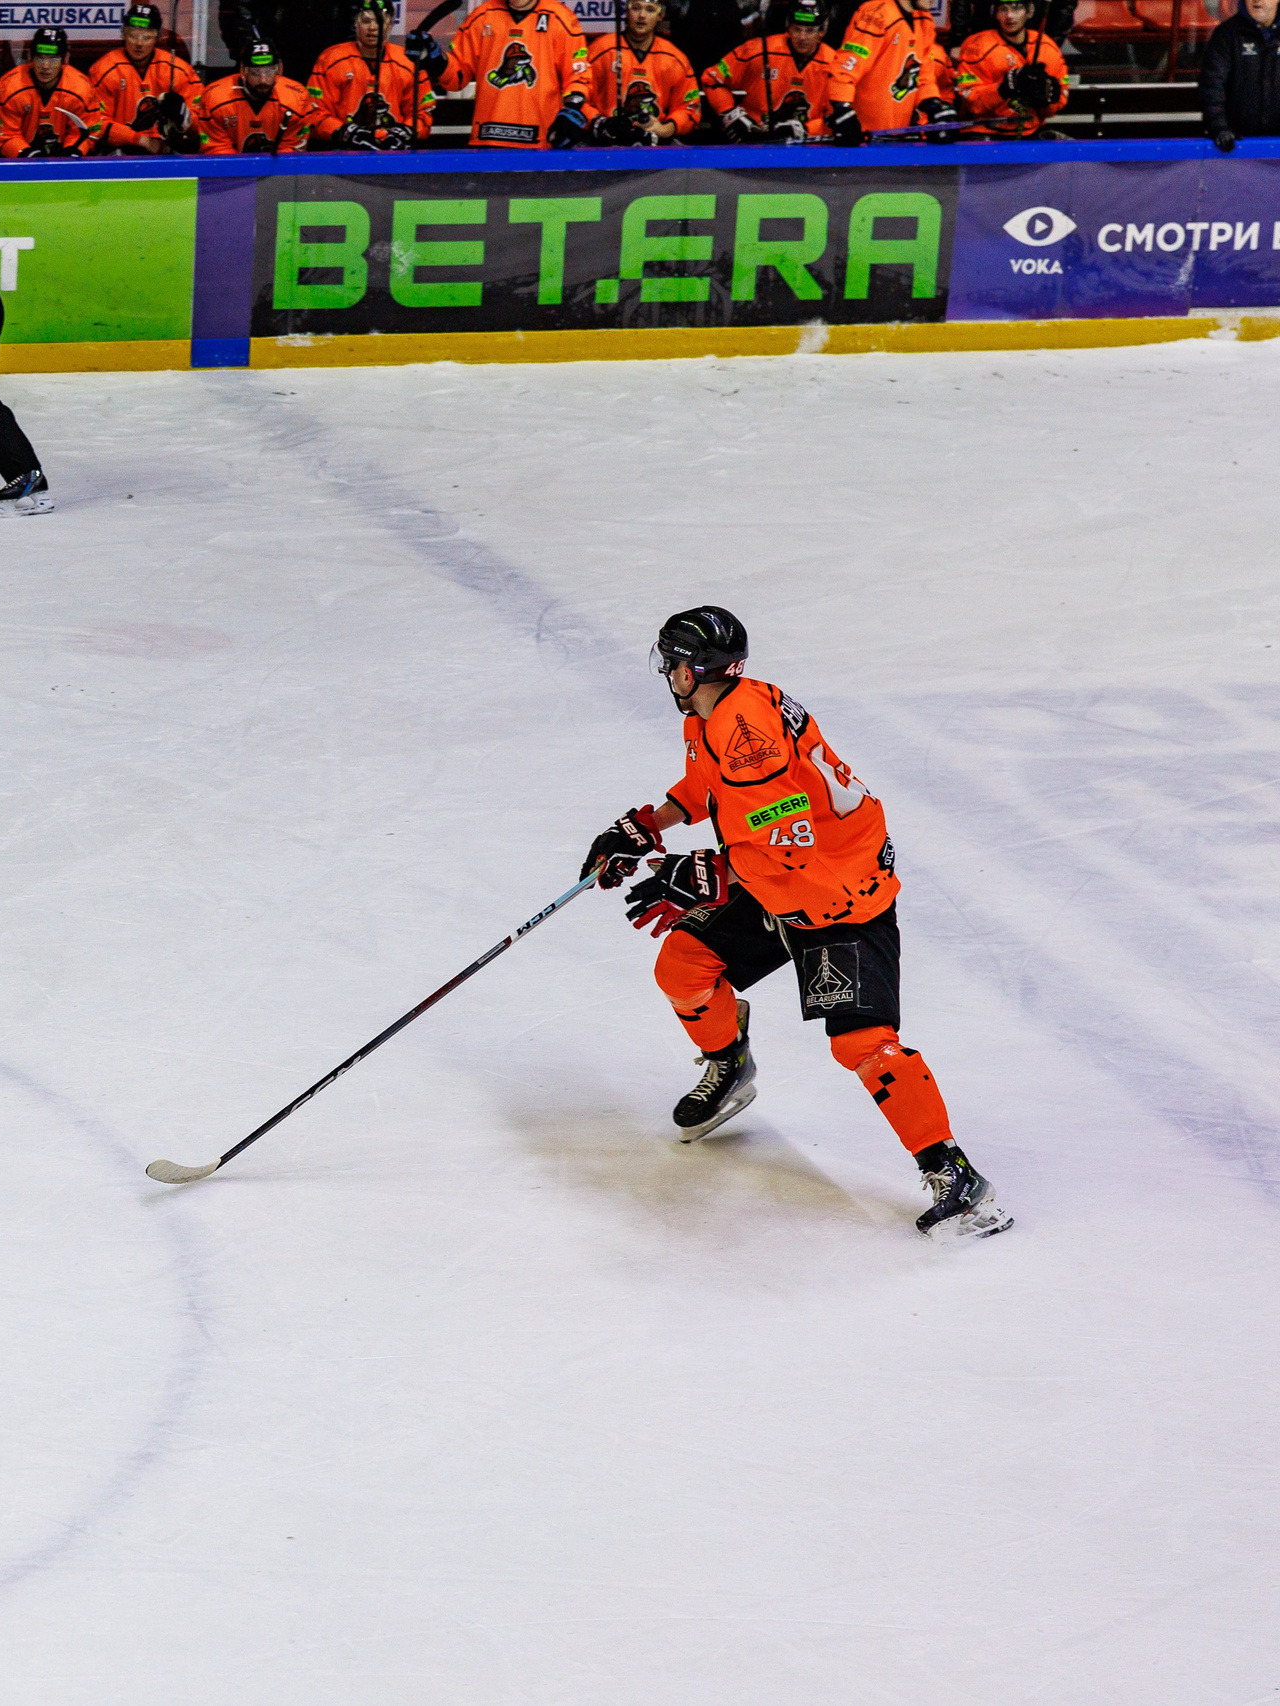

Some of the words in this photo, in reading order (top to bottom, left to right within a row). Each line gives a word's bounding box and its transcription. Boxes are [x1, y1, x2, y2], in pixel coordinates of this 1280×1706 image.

[537, 14, 548, 31] A
[1097, 221, 1261, 253] СМОТРИ
[1009, 258, 1064, 275] VOKA
[673, 646, 693, 656] CCM
[729, 748, 782, 772] BELARUSKALI
[769, 818, 816, 848] 48
[806, 991, 854, 1005] BELARUSKALI
